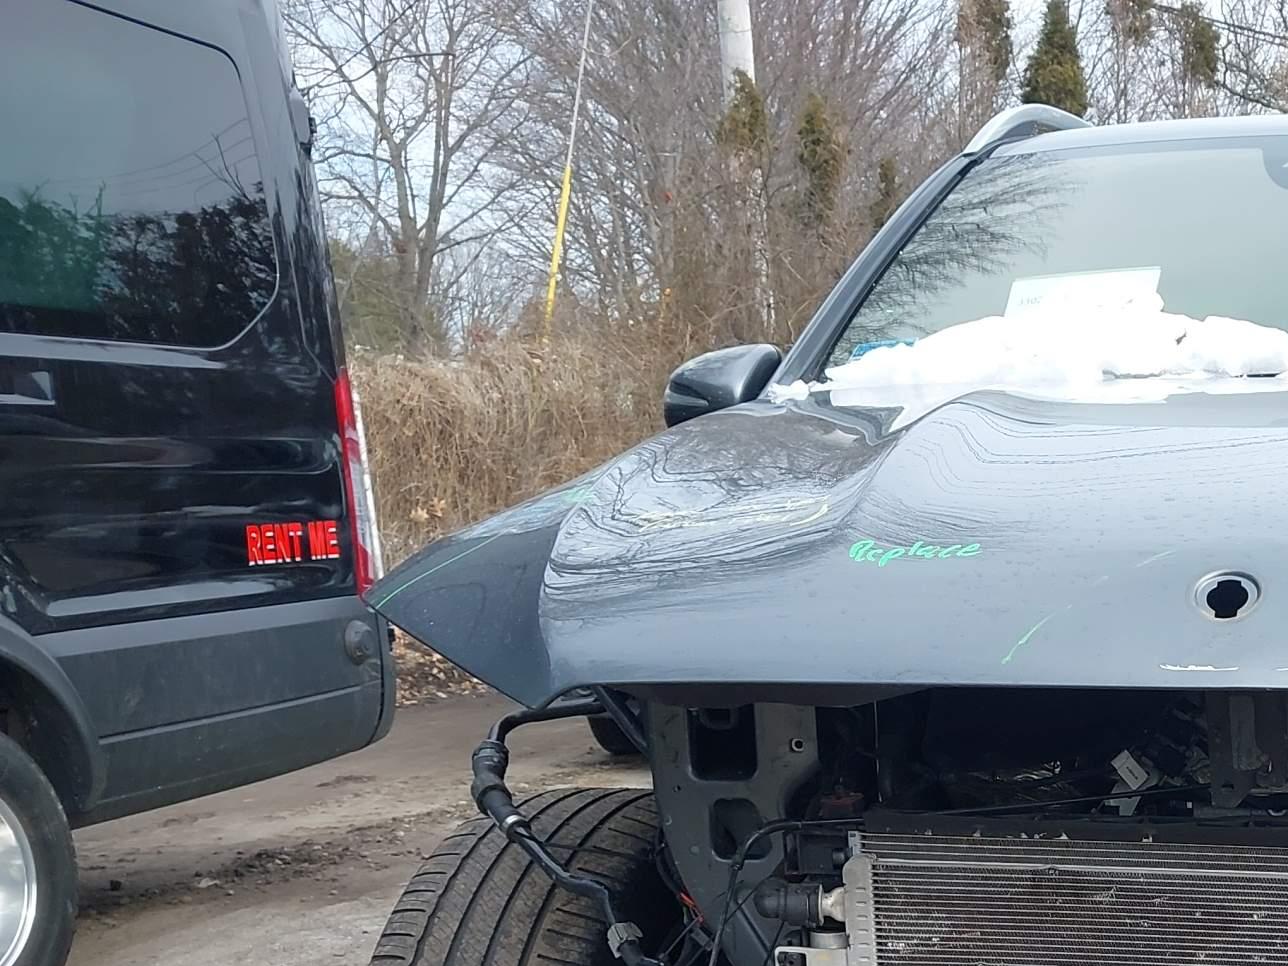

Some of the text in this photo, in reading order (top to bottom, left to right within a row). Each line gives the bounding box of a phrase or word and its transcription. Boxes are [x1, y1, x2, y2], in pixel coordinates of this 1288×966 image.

[246, 520, 340, 566] RENT ME
[849, 539, 984, 567] Replace
